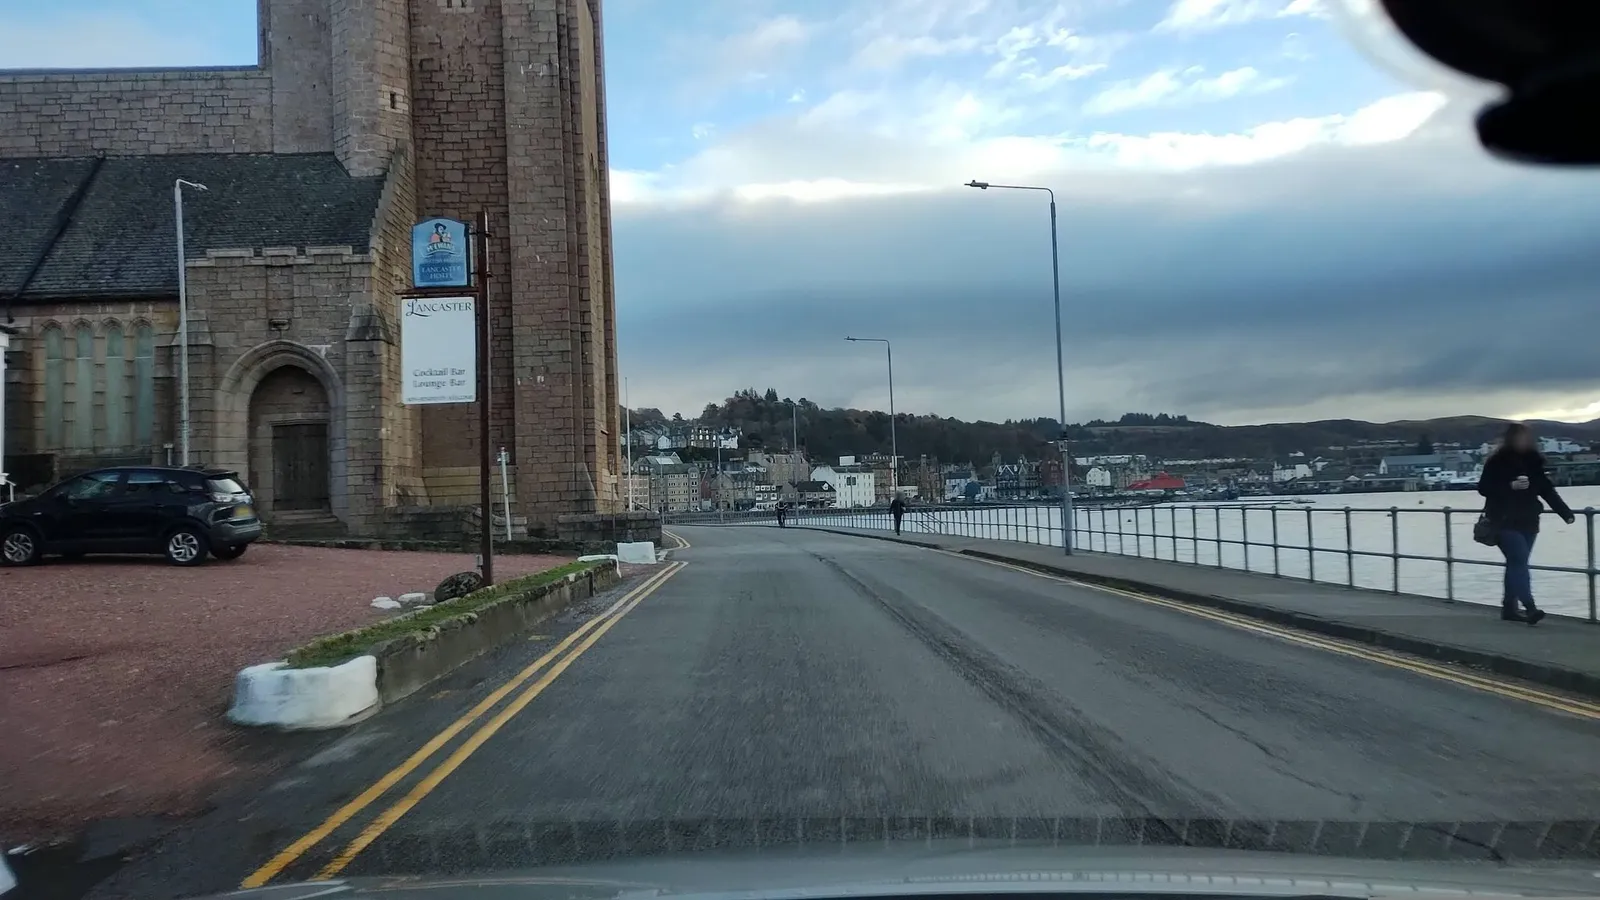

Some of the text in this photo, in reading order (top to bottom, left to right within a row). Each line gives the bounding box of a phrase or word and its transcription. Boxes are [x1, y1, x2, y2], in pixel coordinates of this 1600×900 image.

[412, 367, 466, 377] Cocktail Bar
[412, 379, 466, 390] Lounge Bar
